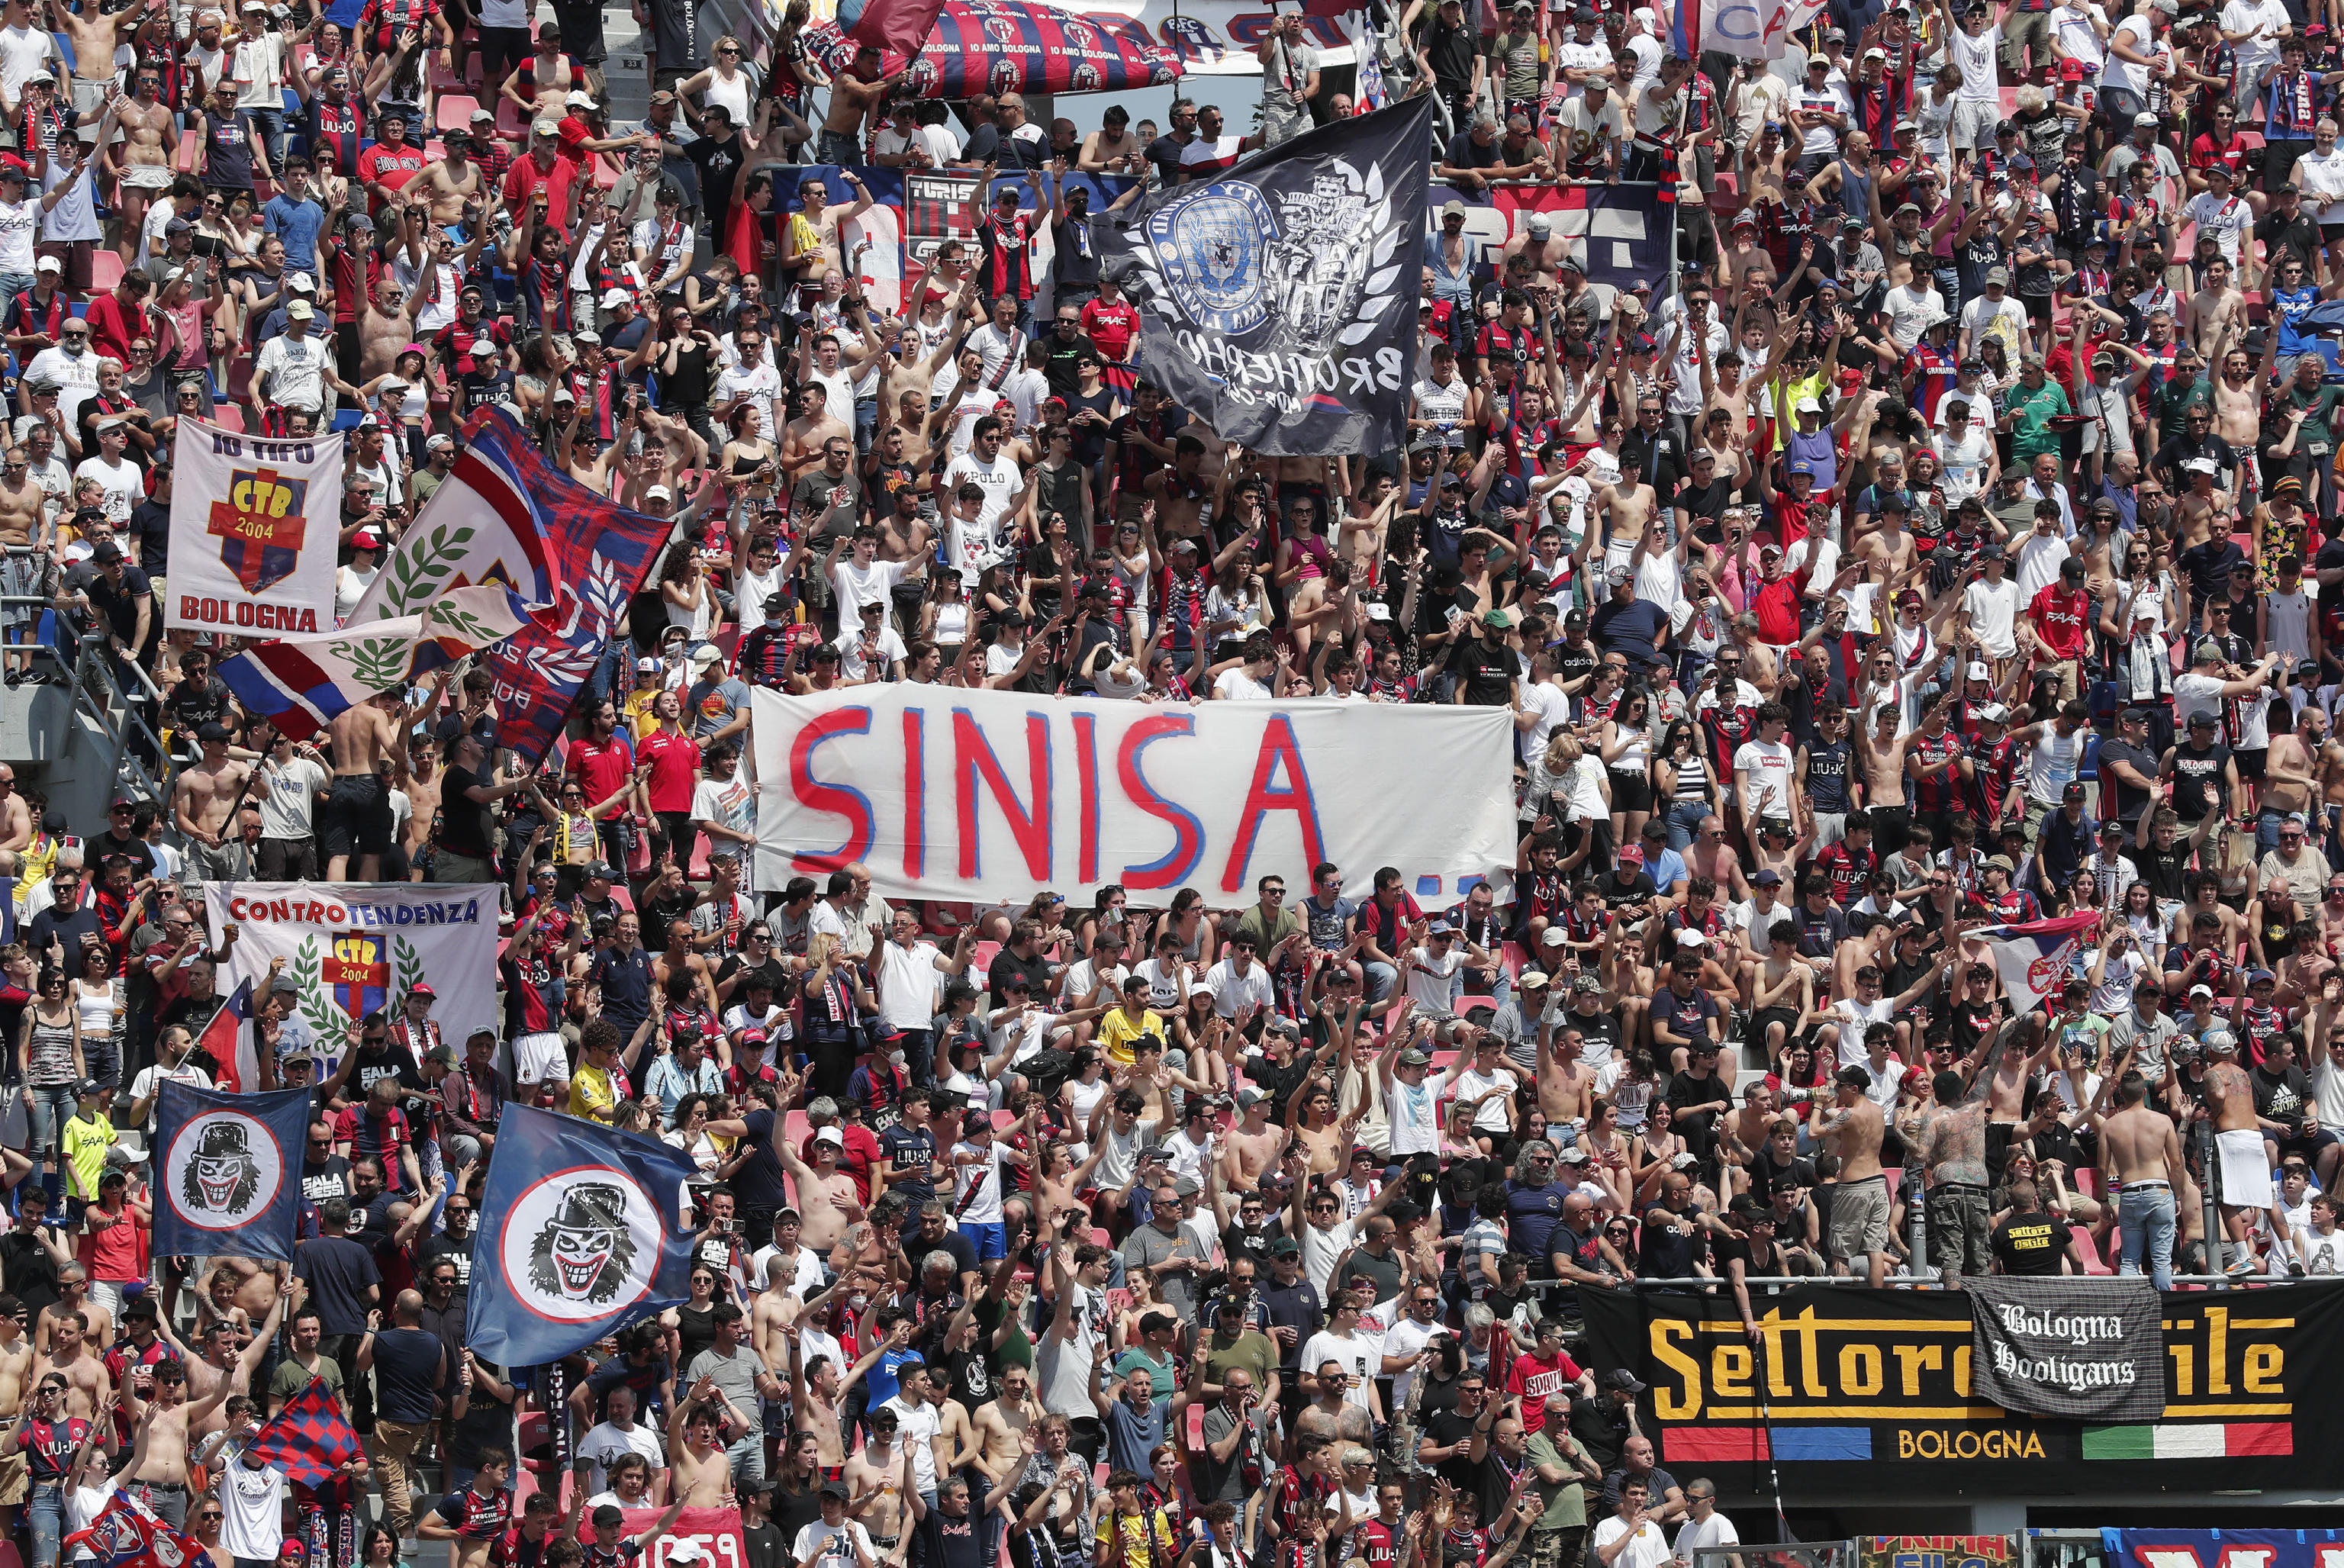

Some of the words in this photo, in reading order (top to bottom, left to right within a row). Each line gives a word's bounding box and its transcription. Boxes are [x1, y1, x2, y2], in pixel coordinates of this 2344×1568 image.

[970, 43, 980, 53] IO
[981, 43, 1000, 53] AMO
[1002, 45, 1042, 54] BOLOGNA
[1050, 46, 1061, 55] IO
[1062, 47, 1081, 57] AMO
[1081, 48, 1121, 60] BOLOGNA
[918, 63, 931, 72] BFC
[1000, 64, 1013, 73] BFC
[320, 120, 356, 134] LIU·JO
[910, 180, 977, 201] TURIS
[2199, 211, 2235, 227] LIU·JO
[1969, 249, 1998, 264] LIU·JO
[1097, 315, 1128, 326] FAAC
[212, 433, 242, 457] IO
[250, 441, 315, 464] TIFO
[970, 470, 1006, 484] POLO
[233, 478, 292, 519] CTB
[234, 516, 274, 539] 2004
[179, 594, 319, 633] BOLOGNA
[2046, 612, 2082, 628] FAAC
[1563, 656, 1593, 667] adida
[182, 710, 220, 723] FAAC
[1921, 749, 1947, 759] facile
[1811, 762, 1846, 776] LIU·JO
[2178, 759, 2217, 771] BOLOGNA
[790, 705, 1328, 895] SINISA
[1830, 870, 1867, 886] LIU·JO
[229, 894, 480, 926] CONTROTENDENZA
[334, 938, 377, 966] CTB
[340, 965, 369, 983] 2004
[1518, 1034, 1537, 1045] PUM
[361, 1064, 401, 1080] SALA
[2271, 1093, 2299, 1107] adidas
[897, 1149, 932, 1164] LIU·JO
[302, 1173, 344, 1189] SALA
[303, 1184, 346, 1200] GESSI
[2008, 1224, 2054, 1238] Settore
[2013, 1236, 2051, 1251] Ostile
[1998, 1303, 2125, 1347] Bologna
[1992, 1338, 2136, 1393] Hooligans
[41, 1440, 82, 1457] LIU·JO
[1898, 1428, 2046, 1459] BOLOGNA
[1370, 1547, 1399, 1563] LIU·J
